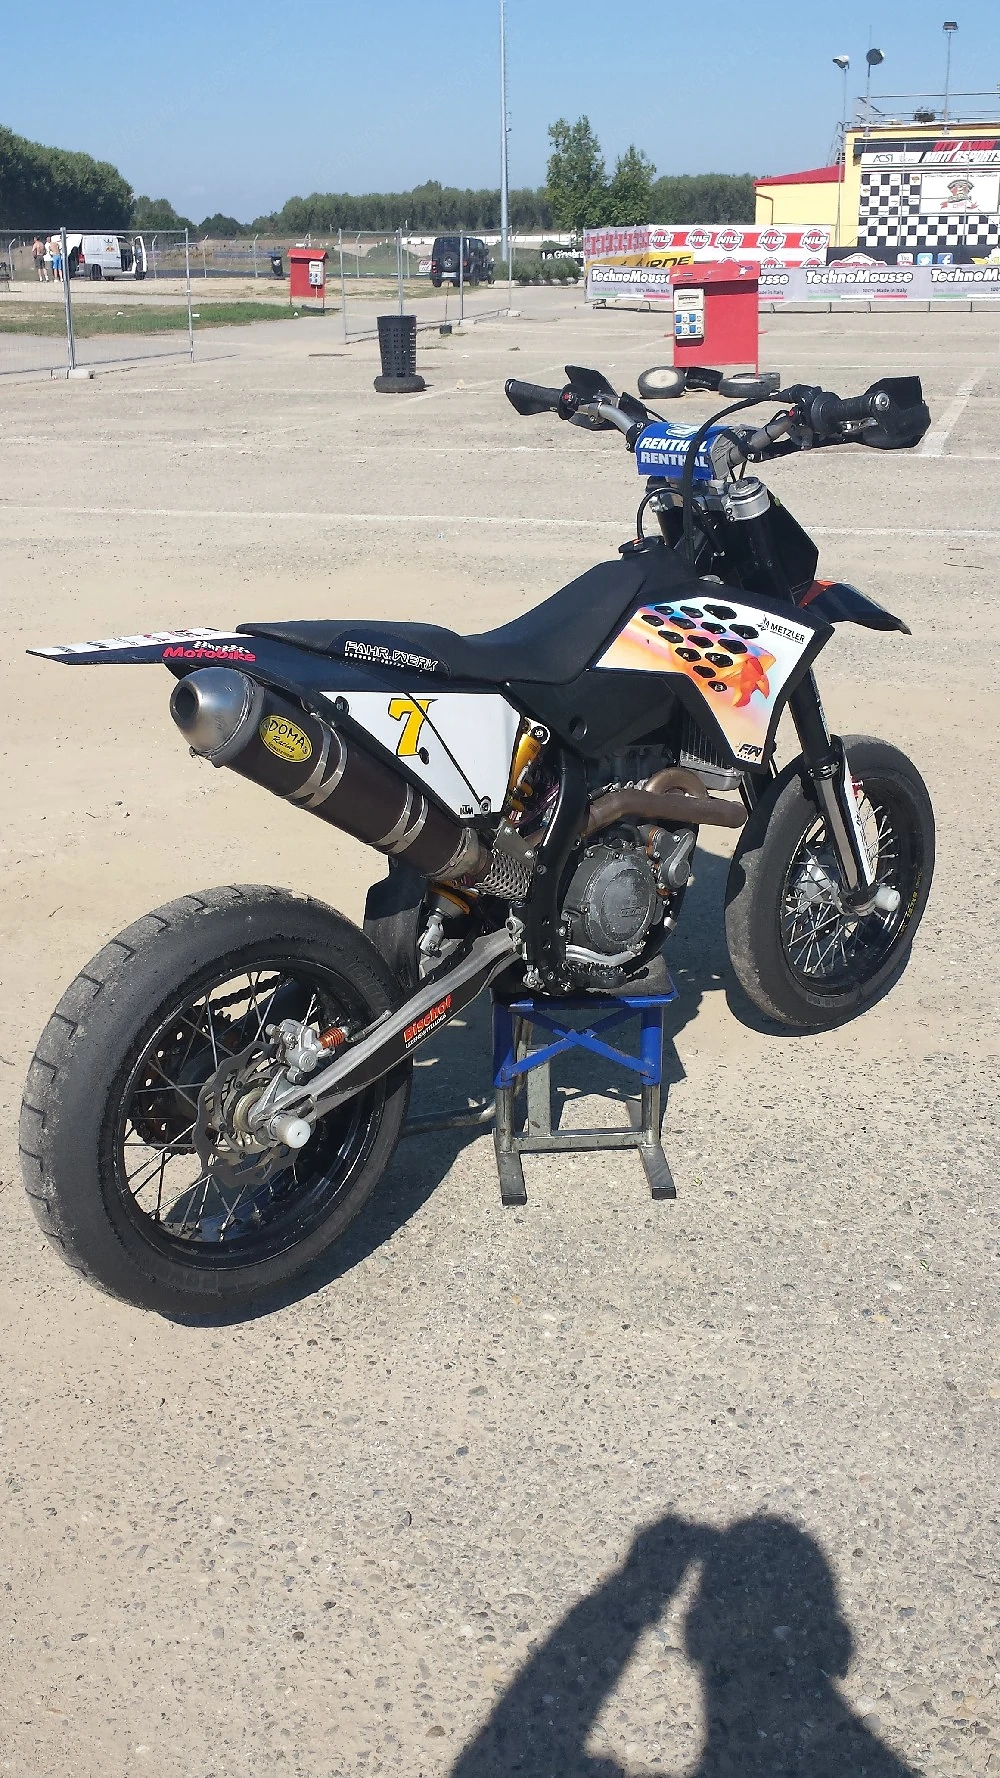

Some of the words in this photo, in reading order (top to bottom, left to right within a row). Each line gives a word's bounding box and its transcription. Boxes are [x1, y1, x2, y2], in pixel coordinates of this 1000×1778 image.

[806, 269, 913, 284] TechnoMousse
[639, 437, 708, 453] RENTHL
[770, 622, 805, 643] METZLER
[162, 646, 256, 662] Motobike
[269, 719, 305, 749] DOMA
[387, 698, 438, 757] 7
[403, 993, 453, 1043] Bischof
